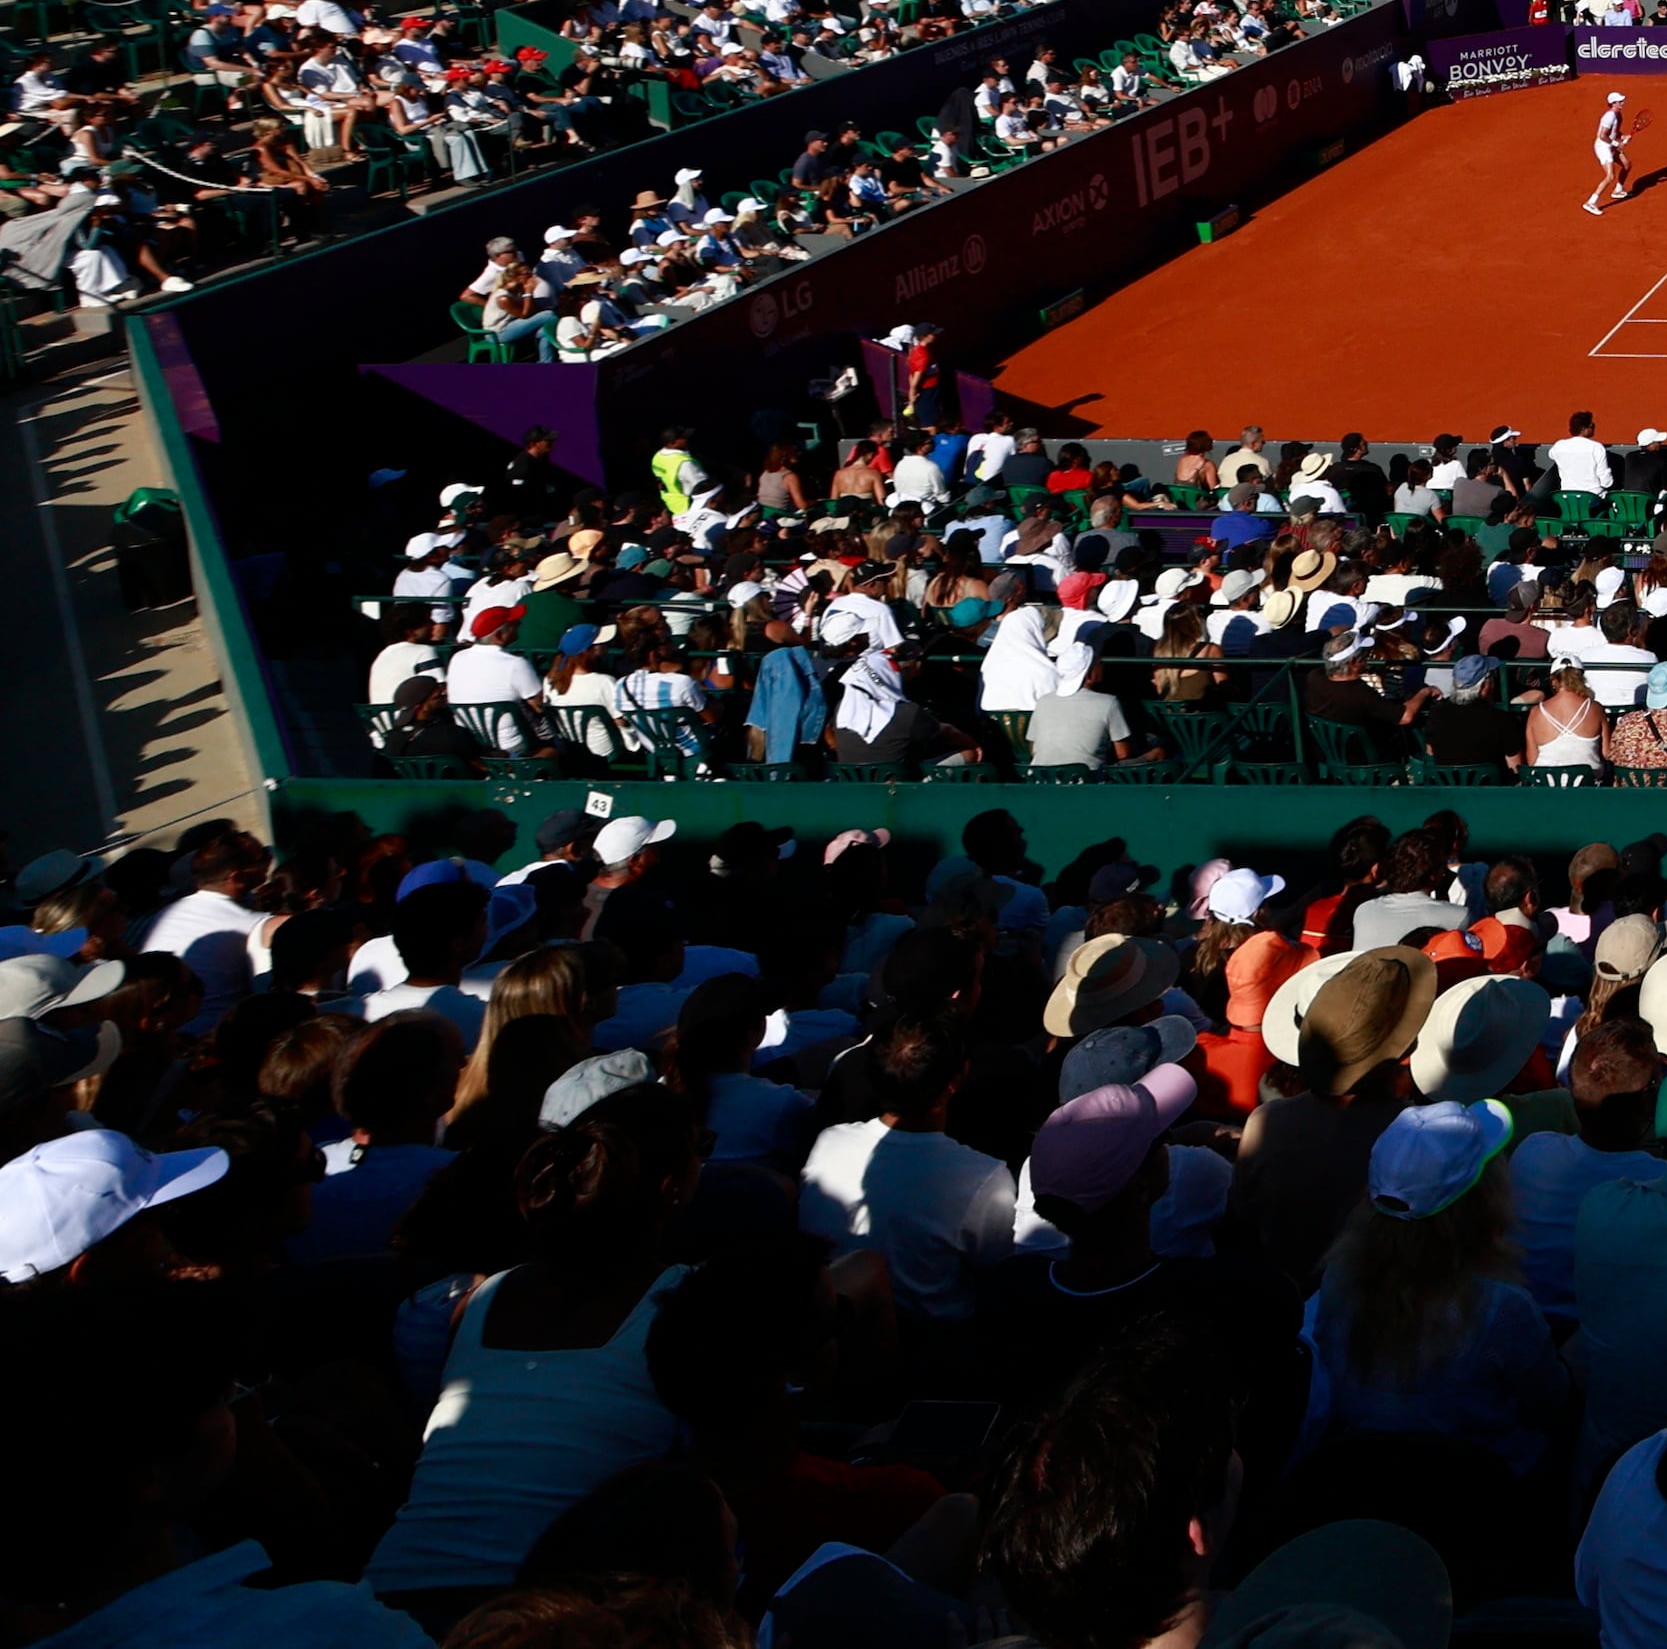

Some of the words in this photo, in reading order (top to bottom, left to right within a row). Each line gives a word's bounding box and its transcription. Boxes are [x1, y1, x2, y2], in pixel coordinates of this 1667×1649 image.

[1449, 54, 1530, 82] BONVOY
[1459, 44, 1519, 61] MARRIOTT
[1131, 94, 1234, 209] IEB+
[1031, 189, 1086, 237] AXION
[894, 253, 960, 305] Allianz
[781, 280, 814, 319] LG
[591, 799, 607, 813] 43
